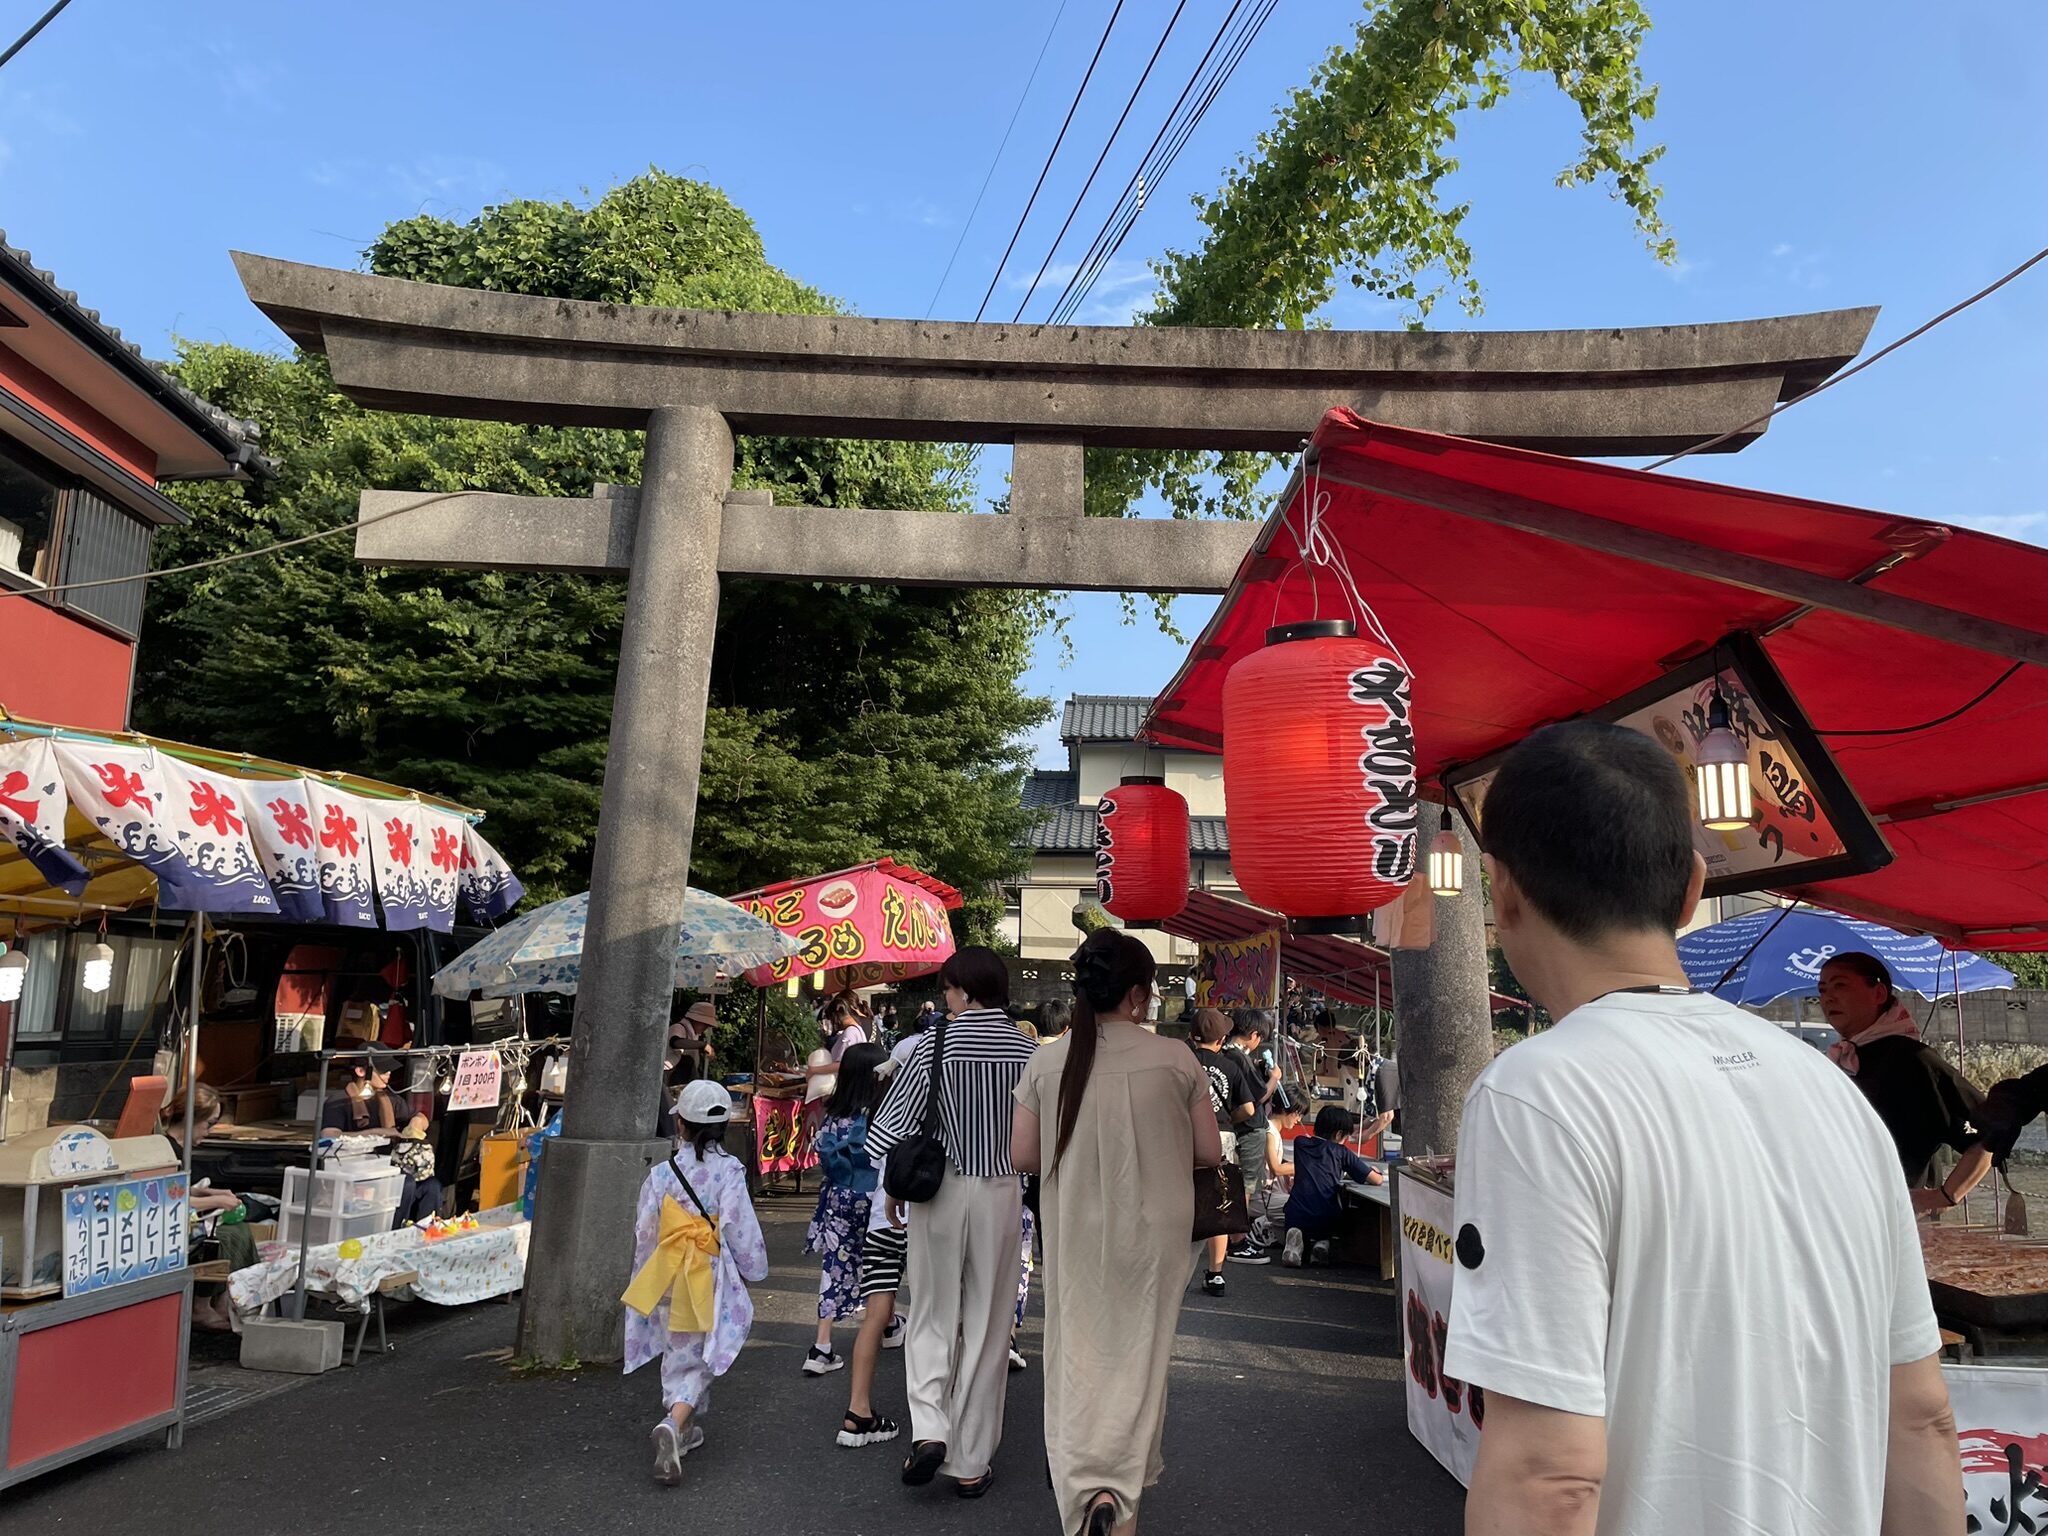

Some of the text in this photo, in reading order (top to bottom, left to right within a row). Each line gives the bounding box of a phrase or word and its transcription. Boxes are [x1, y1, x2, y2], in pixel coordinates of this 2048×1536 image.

[188, 779, 244, 836] 氷
[266, 797, 315, 850] 氷
[319, 803, 360, 859] 氷
[473, 1072, 496, 1086] 300円
[95, 1217, 109, 1283] コーラ
[120, 1211, 134, 1279] メロン
[168, 1201, 182, 1267] イチゴ
